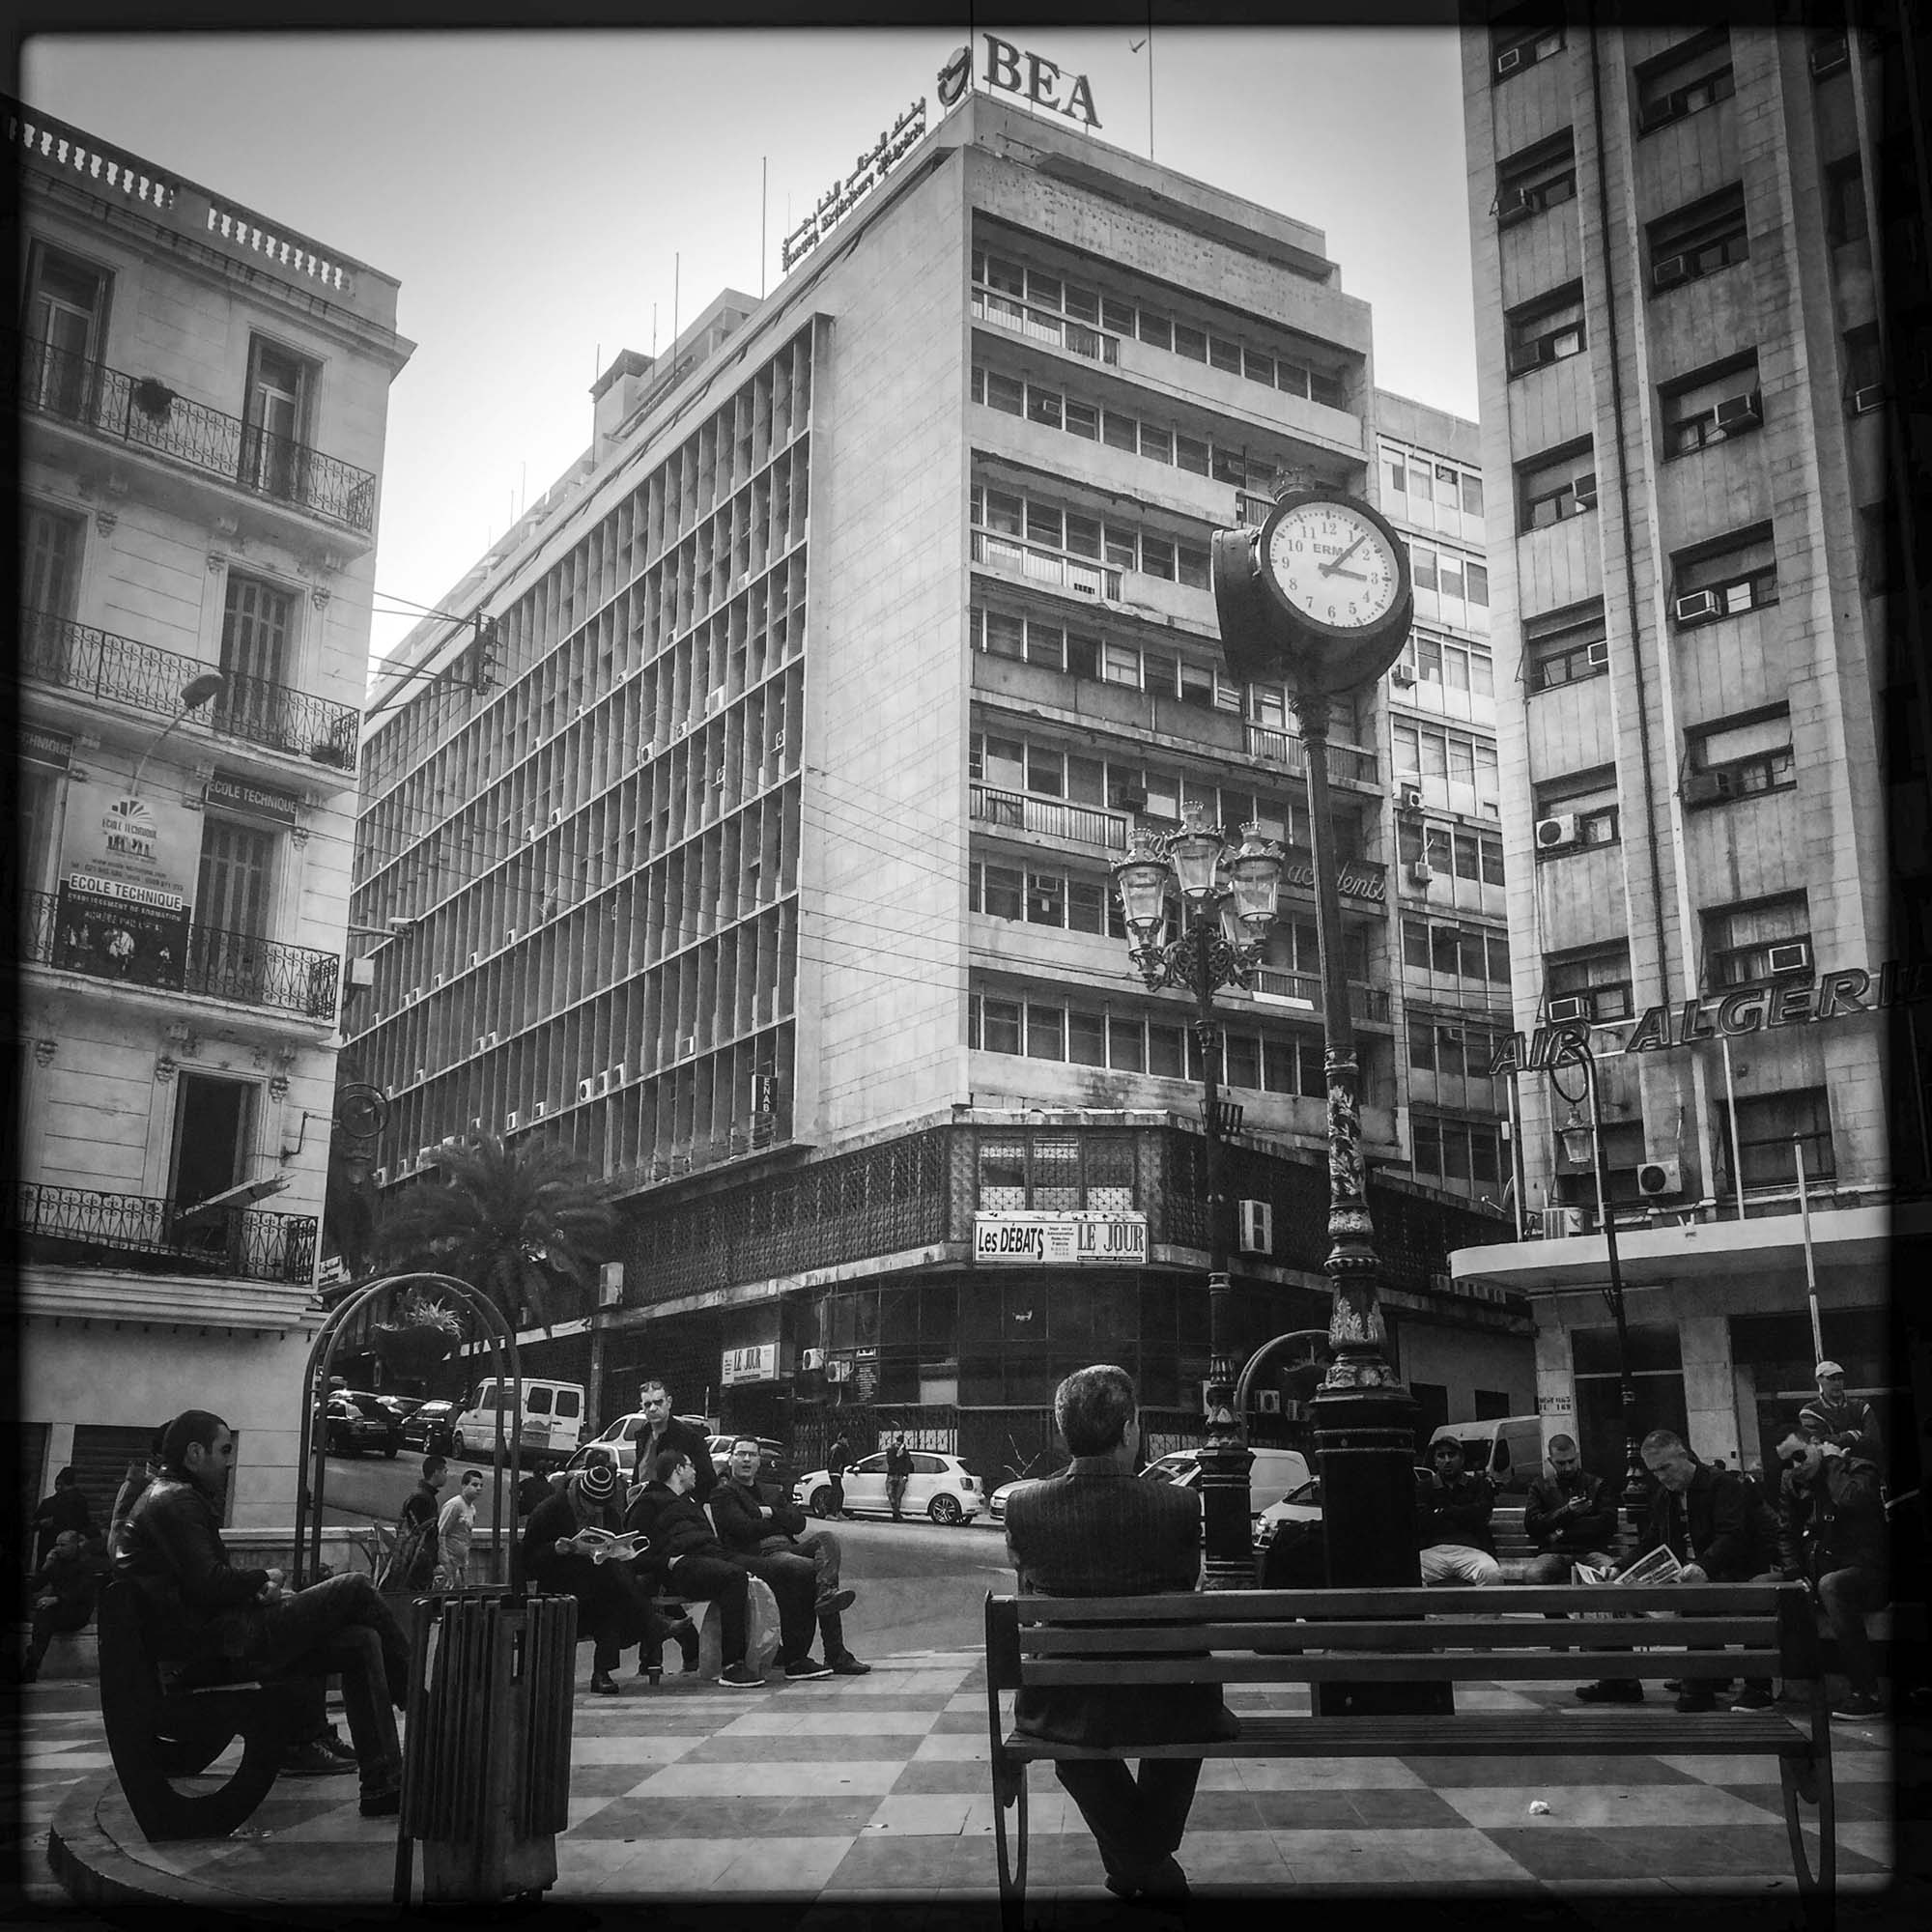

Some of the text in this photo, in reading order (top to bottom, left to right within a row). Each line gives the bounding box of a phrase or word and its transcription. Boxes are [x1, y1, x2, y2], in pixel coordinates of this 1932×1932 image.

[982, 33, 1102, 128] BEA
[1302, 526, 1317, 539] 11
[1322, 522, 1337, 535] 12
[1349, 529, 1354, 542] 1
[1288, 539, 1303, 553] 10
[1313, 543, 1352, 558] ERM
[1362, 549, 1370, 561] 2
[1282, 556, 1290, 569] 9
[1289, 578, 1297, 590] 8
[1371, 572, 1378, 584] 3
[1306, 596, 1314, 609] 7
[1362, 590, 1370, 604] 4
[1327, 605, 1336, 618] 6
[1349, 602, 1357, 614] 5
[209, 780, 298, 814] ECOLE TECHNIQUE
[70, 874, 111, 895] ECOLE
[115, 883, 183, 909] TECHNIQUE
[1489, 1019, 1592, 1075] AIR
[762, 1077, 772, 1113] ENAB
[978, 1226, 998, 1253] Les
[1000, 1223, 1044, 1261] DÉBATS
[1077, 1223, 1096, 1251] LE
[1103, 1223, 1145, 1253] JOUR
